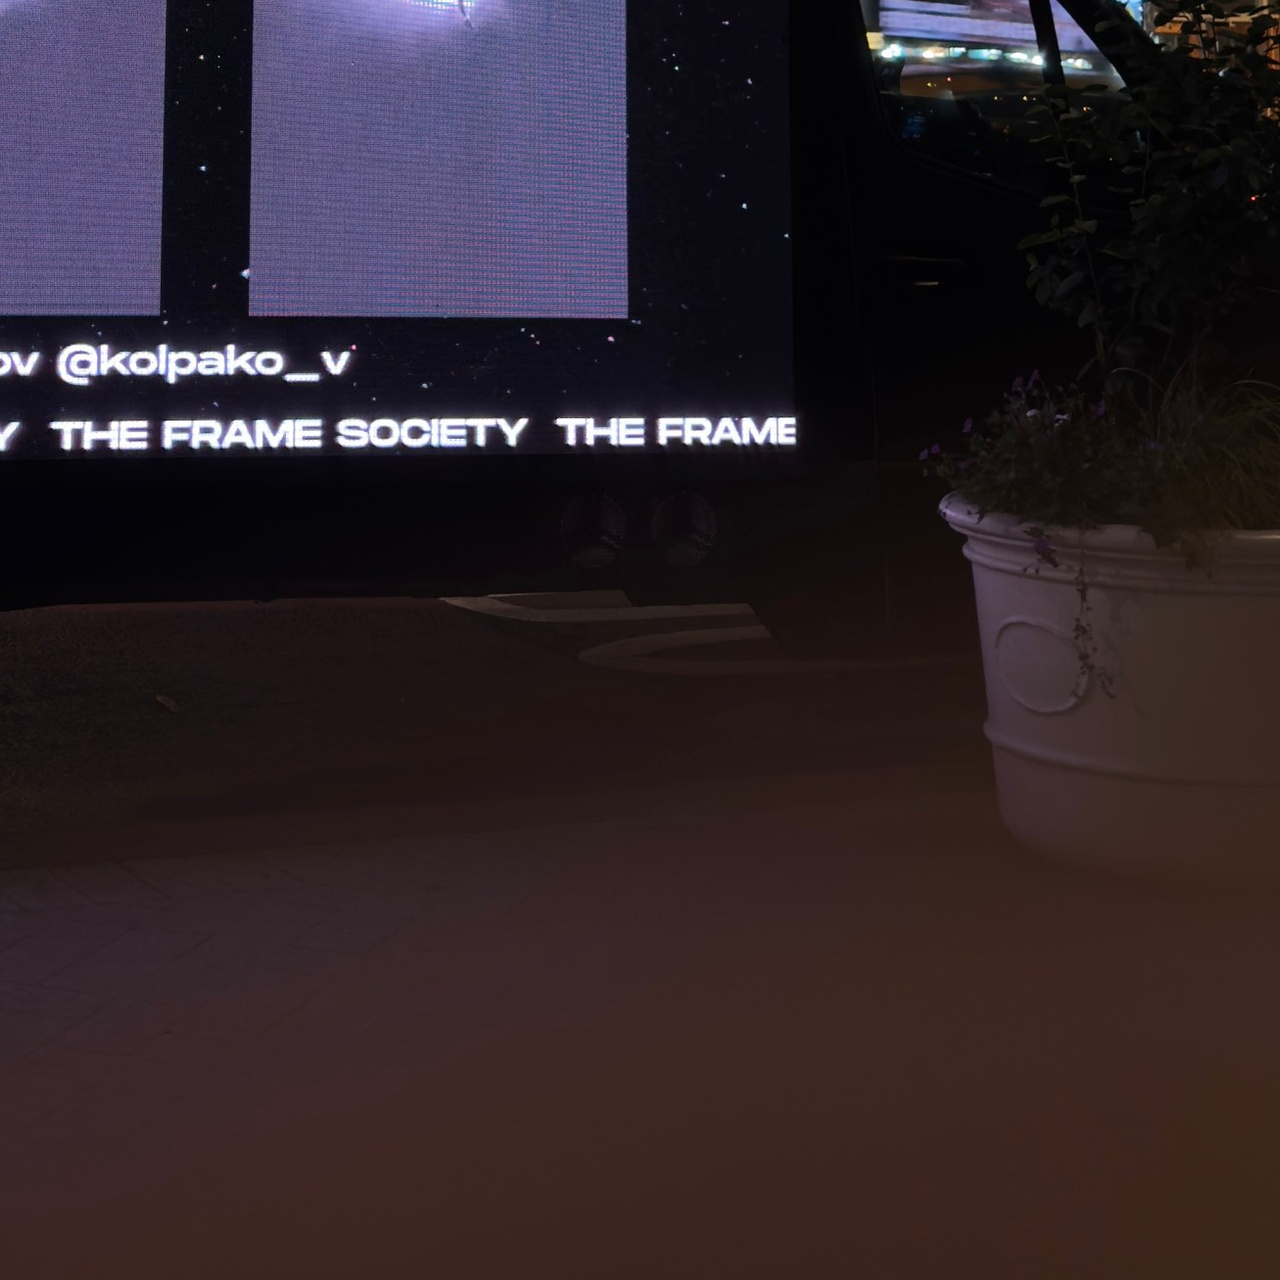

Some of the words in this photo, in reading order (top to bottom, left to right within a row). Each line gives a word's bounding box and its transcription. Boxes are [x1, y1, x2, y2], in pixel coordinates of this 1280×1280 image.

[56, 343, 351, 386] @kolpako_v
[49, 419, 150, 451] THE
[161, 418, 324, 450] FRAME
[335, 417, 529, 449] SOCIETY
[554, 417, 646, 447] THE
[656, 416, 797, 446] FRAME
